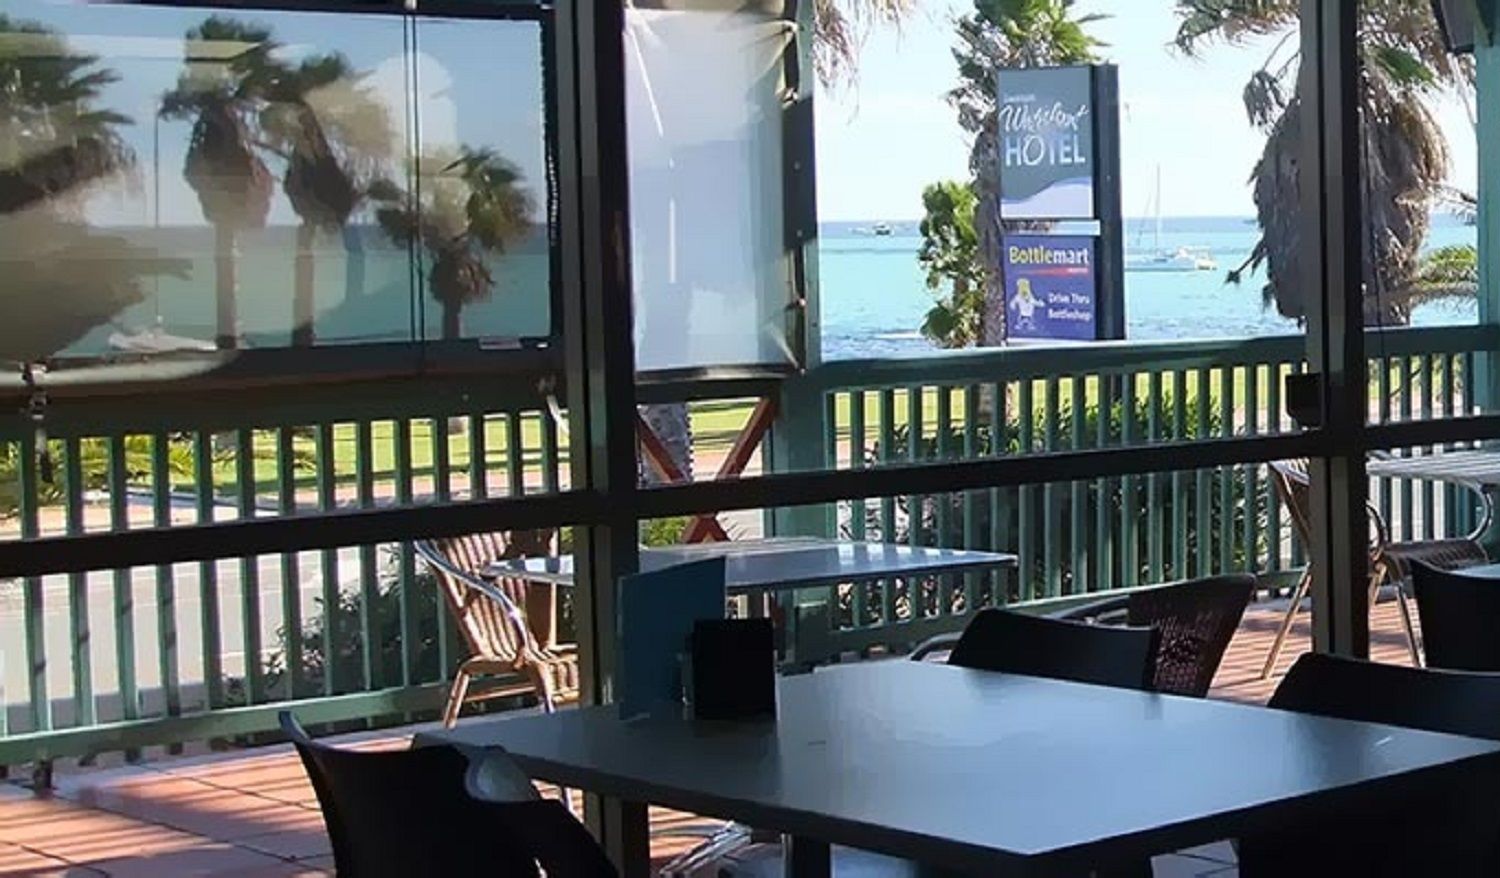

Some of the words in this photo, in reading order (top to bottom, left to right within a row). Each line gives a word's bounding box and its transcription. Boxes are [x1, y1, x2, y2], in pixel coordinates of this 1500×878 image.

[1005, 133, 1086, 166] HOTEL
[1009, 245, 1089, 264] Bottlemart
[1048, 292, 1070, 304] Drive
